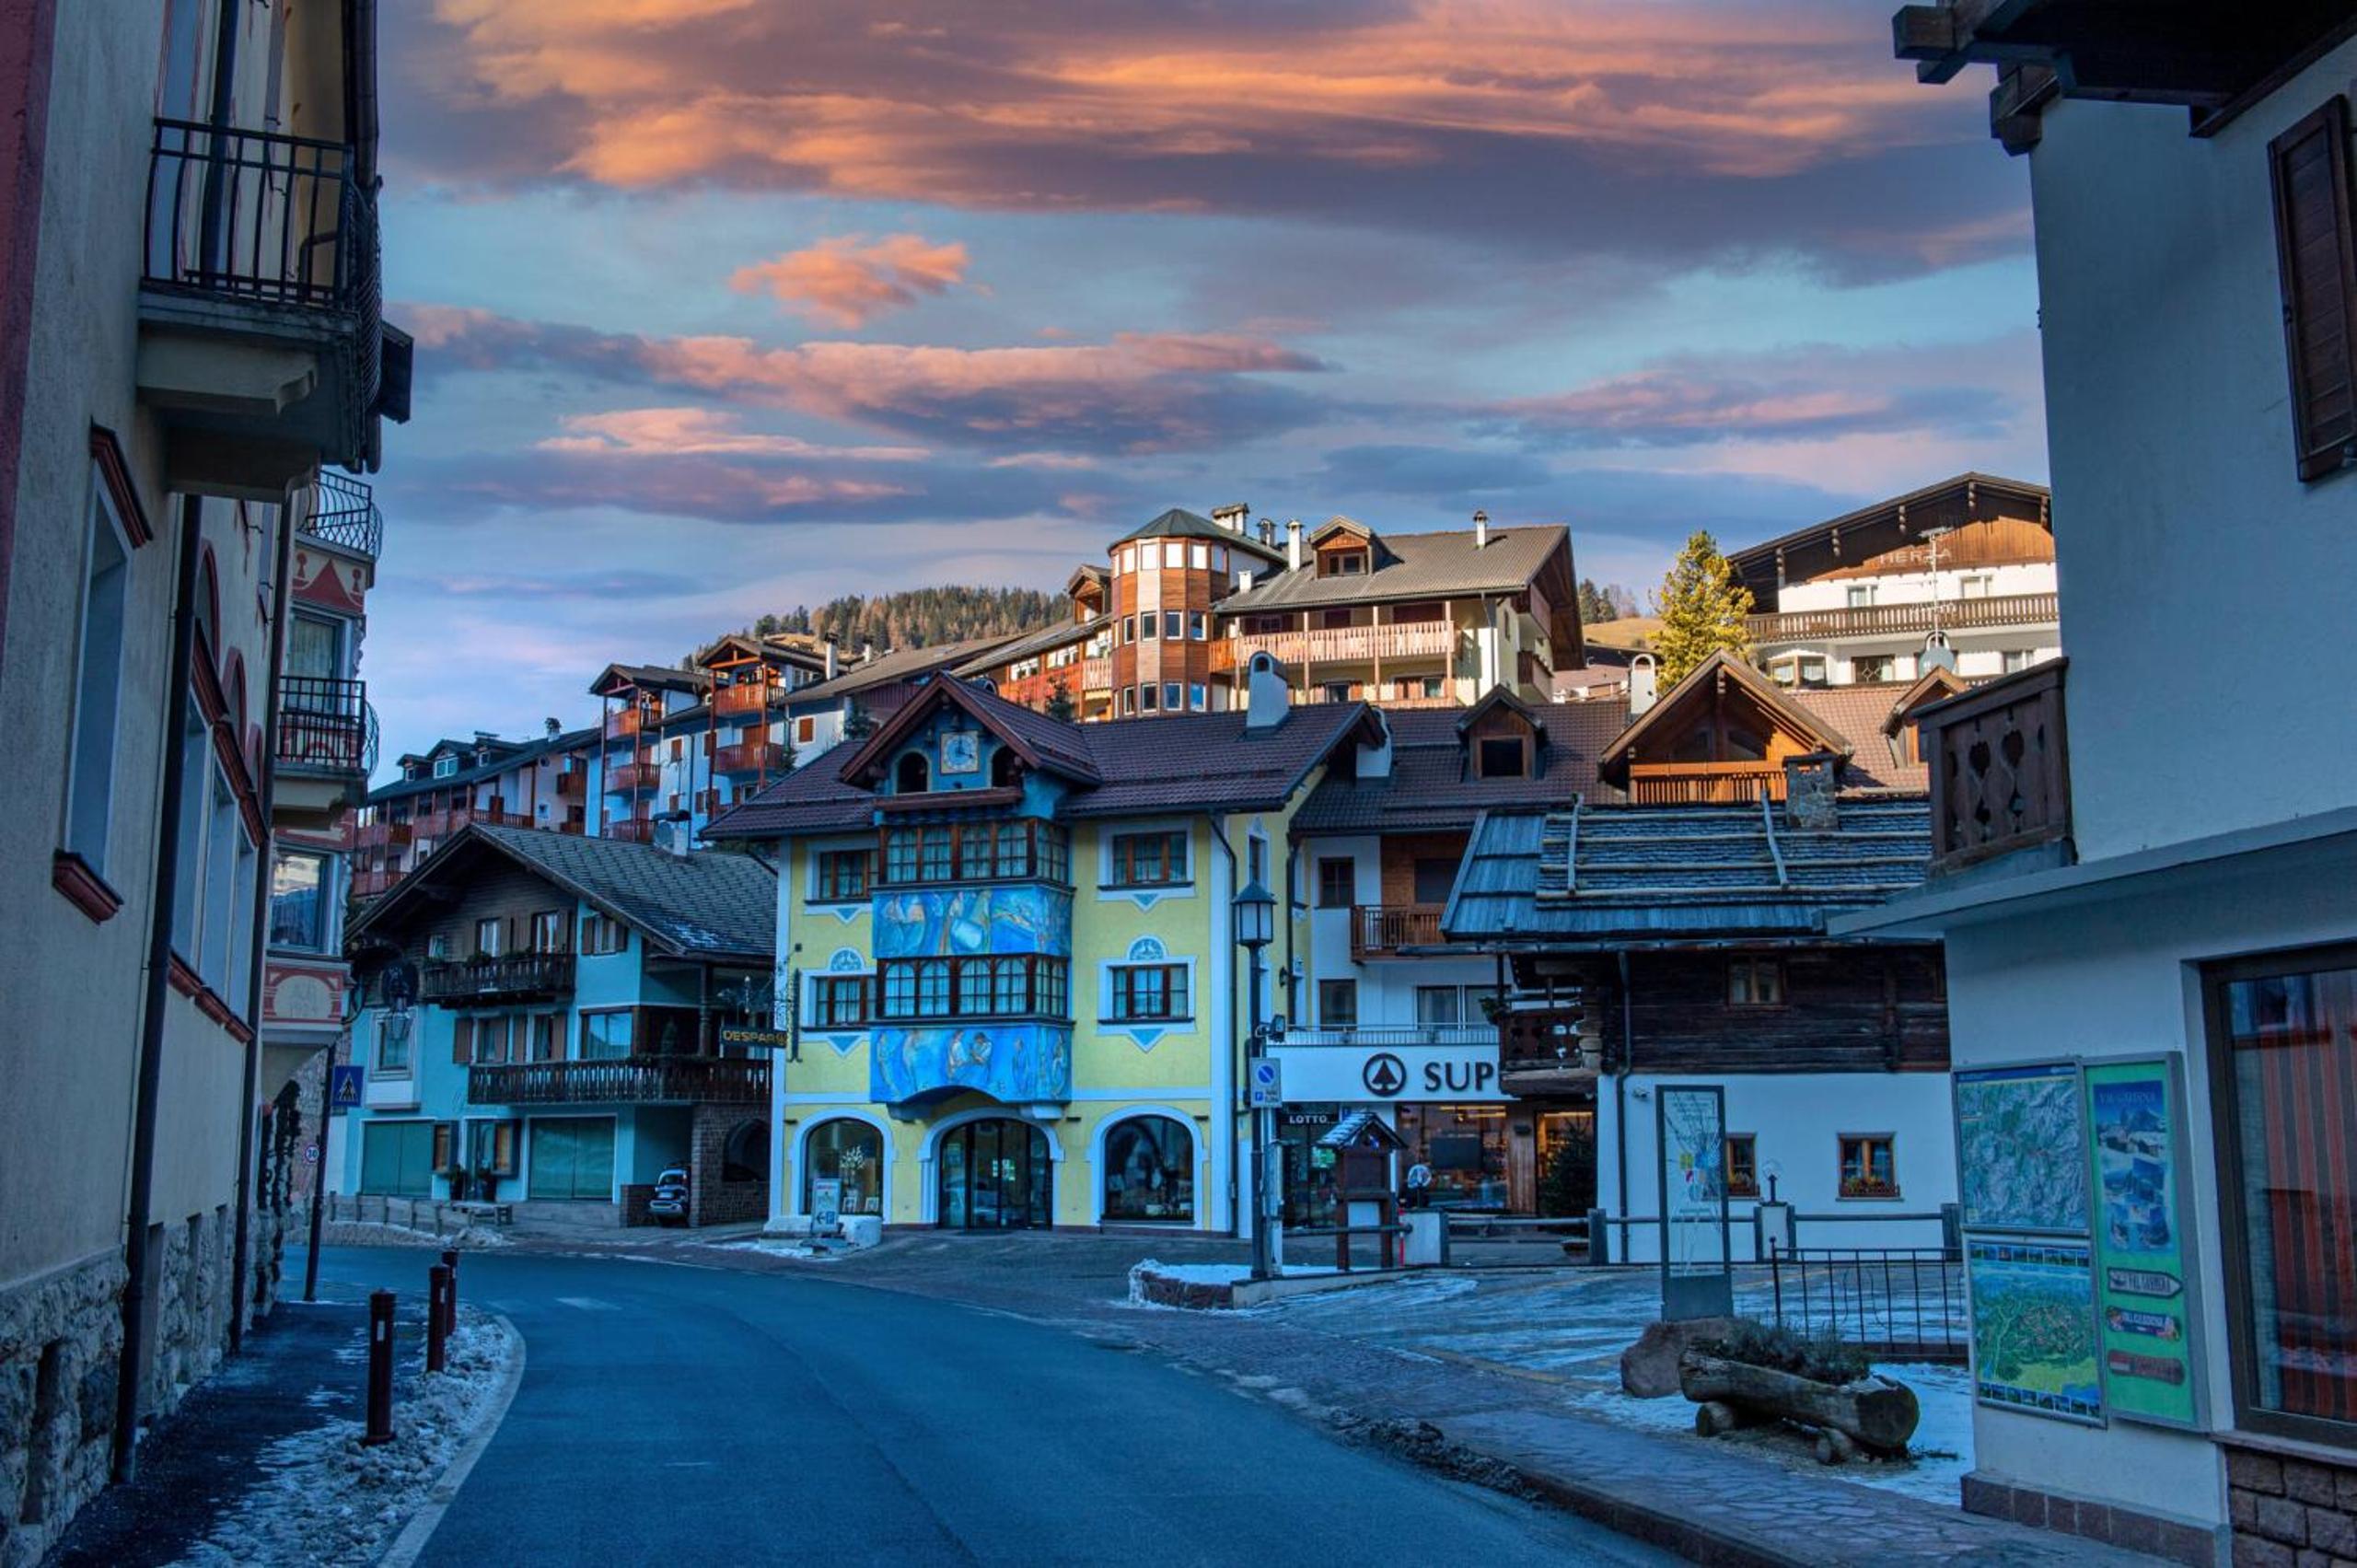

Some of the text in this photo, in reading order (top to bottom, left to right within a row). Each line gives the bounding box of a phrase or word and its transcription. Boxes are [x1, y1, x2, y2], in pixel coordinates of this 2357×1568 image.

[723, 1030, 774, 1043] DESPAR
[1424, 1062, 1493, 1092] SUP
[1289, 1114, 1327, 1123] LOTTO
